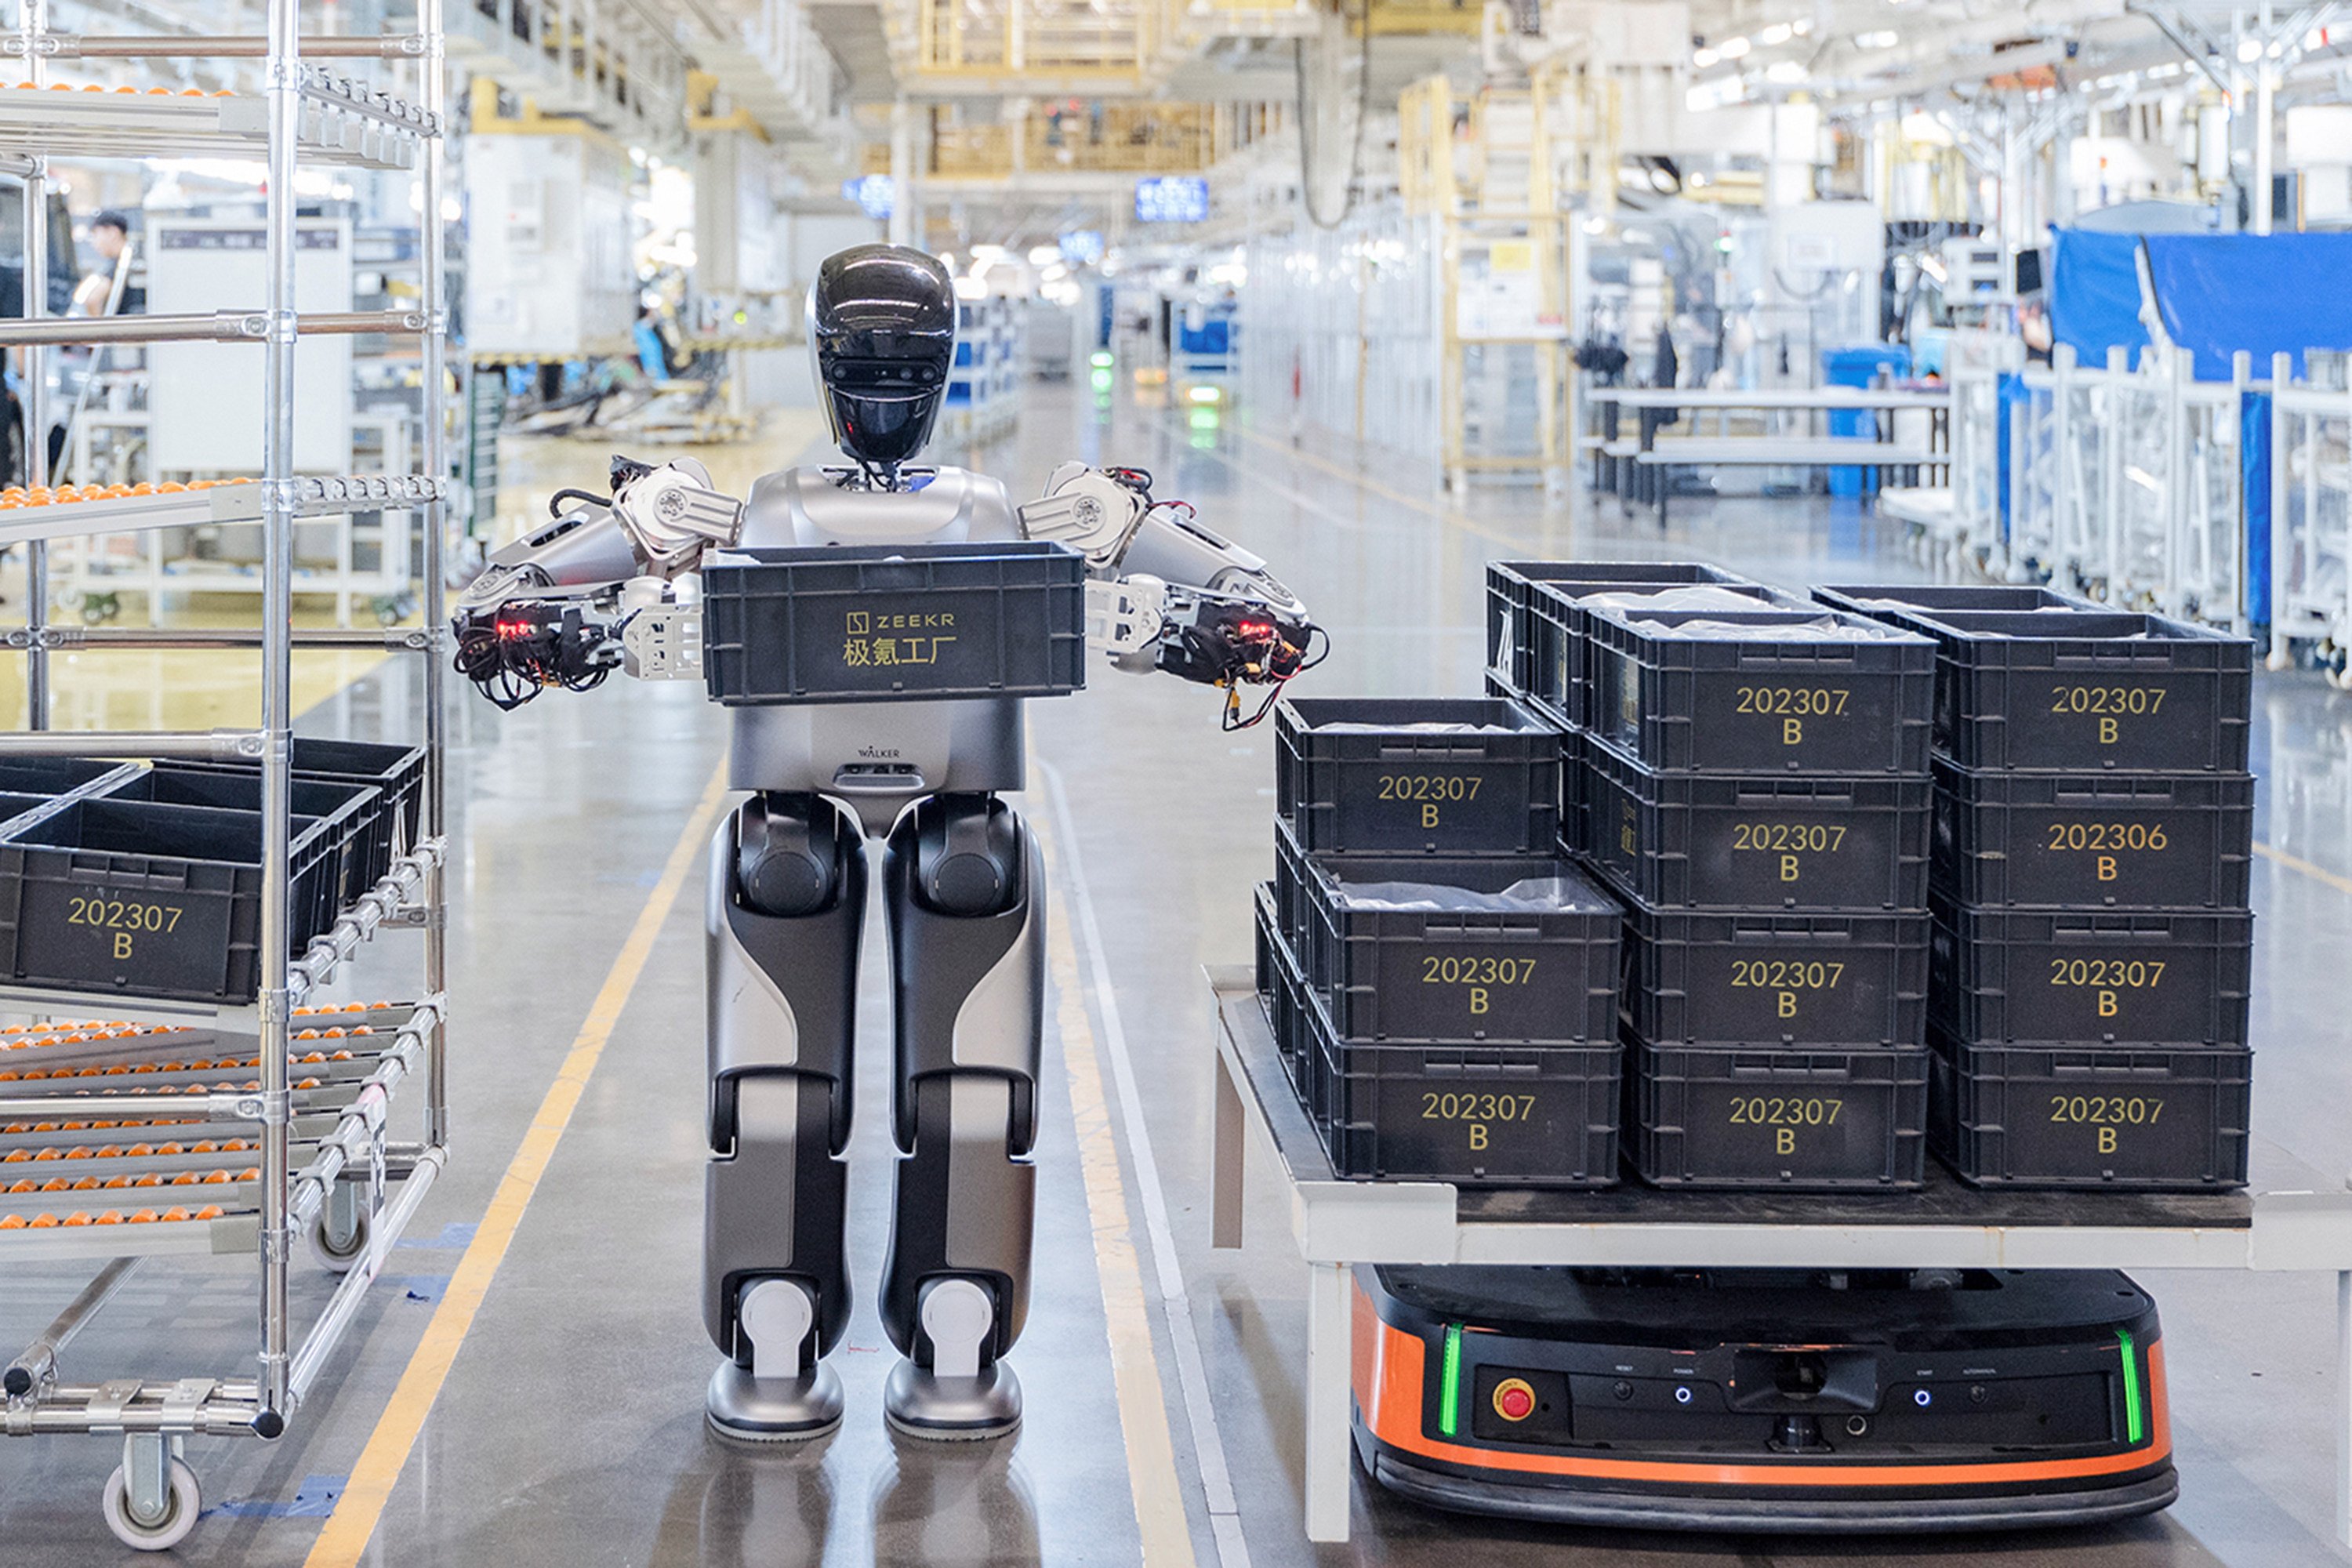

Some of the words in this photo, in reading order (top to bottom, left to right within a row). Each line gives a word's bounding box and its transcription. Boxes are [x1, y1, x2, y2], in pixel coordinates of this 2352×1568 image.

[877, 614, 955, 629] ZEEKR
[843, 637, 957, 666] 极氪工厂
[1737, 687, 1849, 715] 202307
[2052, 687, 2167, 714] 202307
[1783, 718, 1802, 745] B
[2100, 717, 2119, 744] B
[858, 746, 900, 758] WALKER
[1378, 775, 1483, 800] 202307
[1421, 804, 1439, 829] B
[1733, 824, 1846, 851] 202307
[2049, 823, 2169, 851] 202306
[1780, 855, 1799, 881] B
[2097, 855, 2118, 882] B
[67, 897, 183, 933] 202307
[113, 932, 133, 960] B
[1422, 956, 1537, 985] 202307
[1731, 960, 1845, 989] 202307
[2050, 959, 2166, 988] 202307
[1470, 987, 1490, 1014] B
[1778, 991, 1798, 1018] B
[2098, 989, 2118, 1017] B
[1422, 1093, 1535, 1121] 202307
[1730, 1097, 1843, 1125] 202307
[2050, 1096, 2165, 1123] 202307
[1469, 1123, 1489, 1150] B
[1777, 1128, 1795, 1155] B
[2098, 1127, 2118, 1154] B
